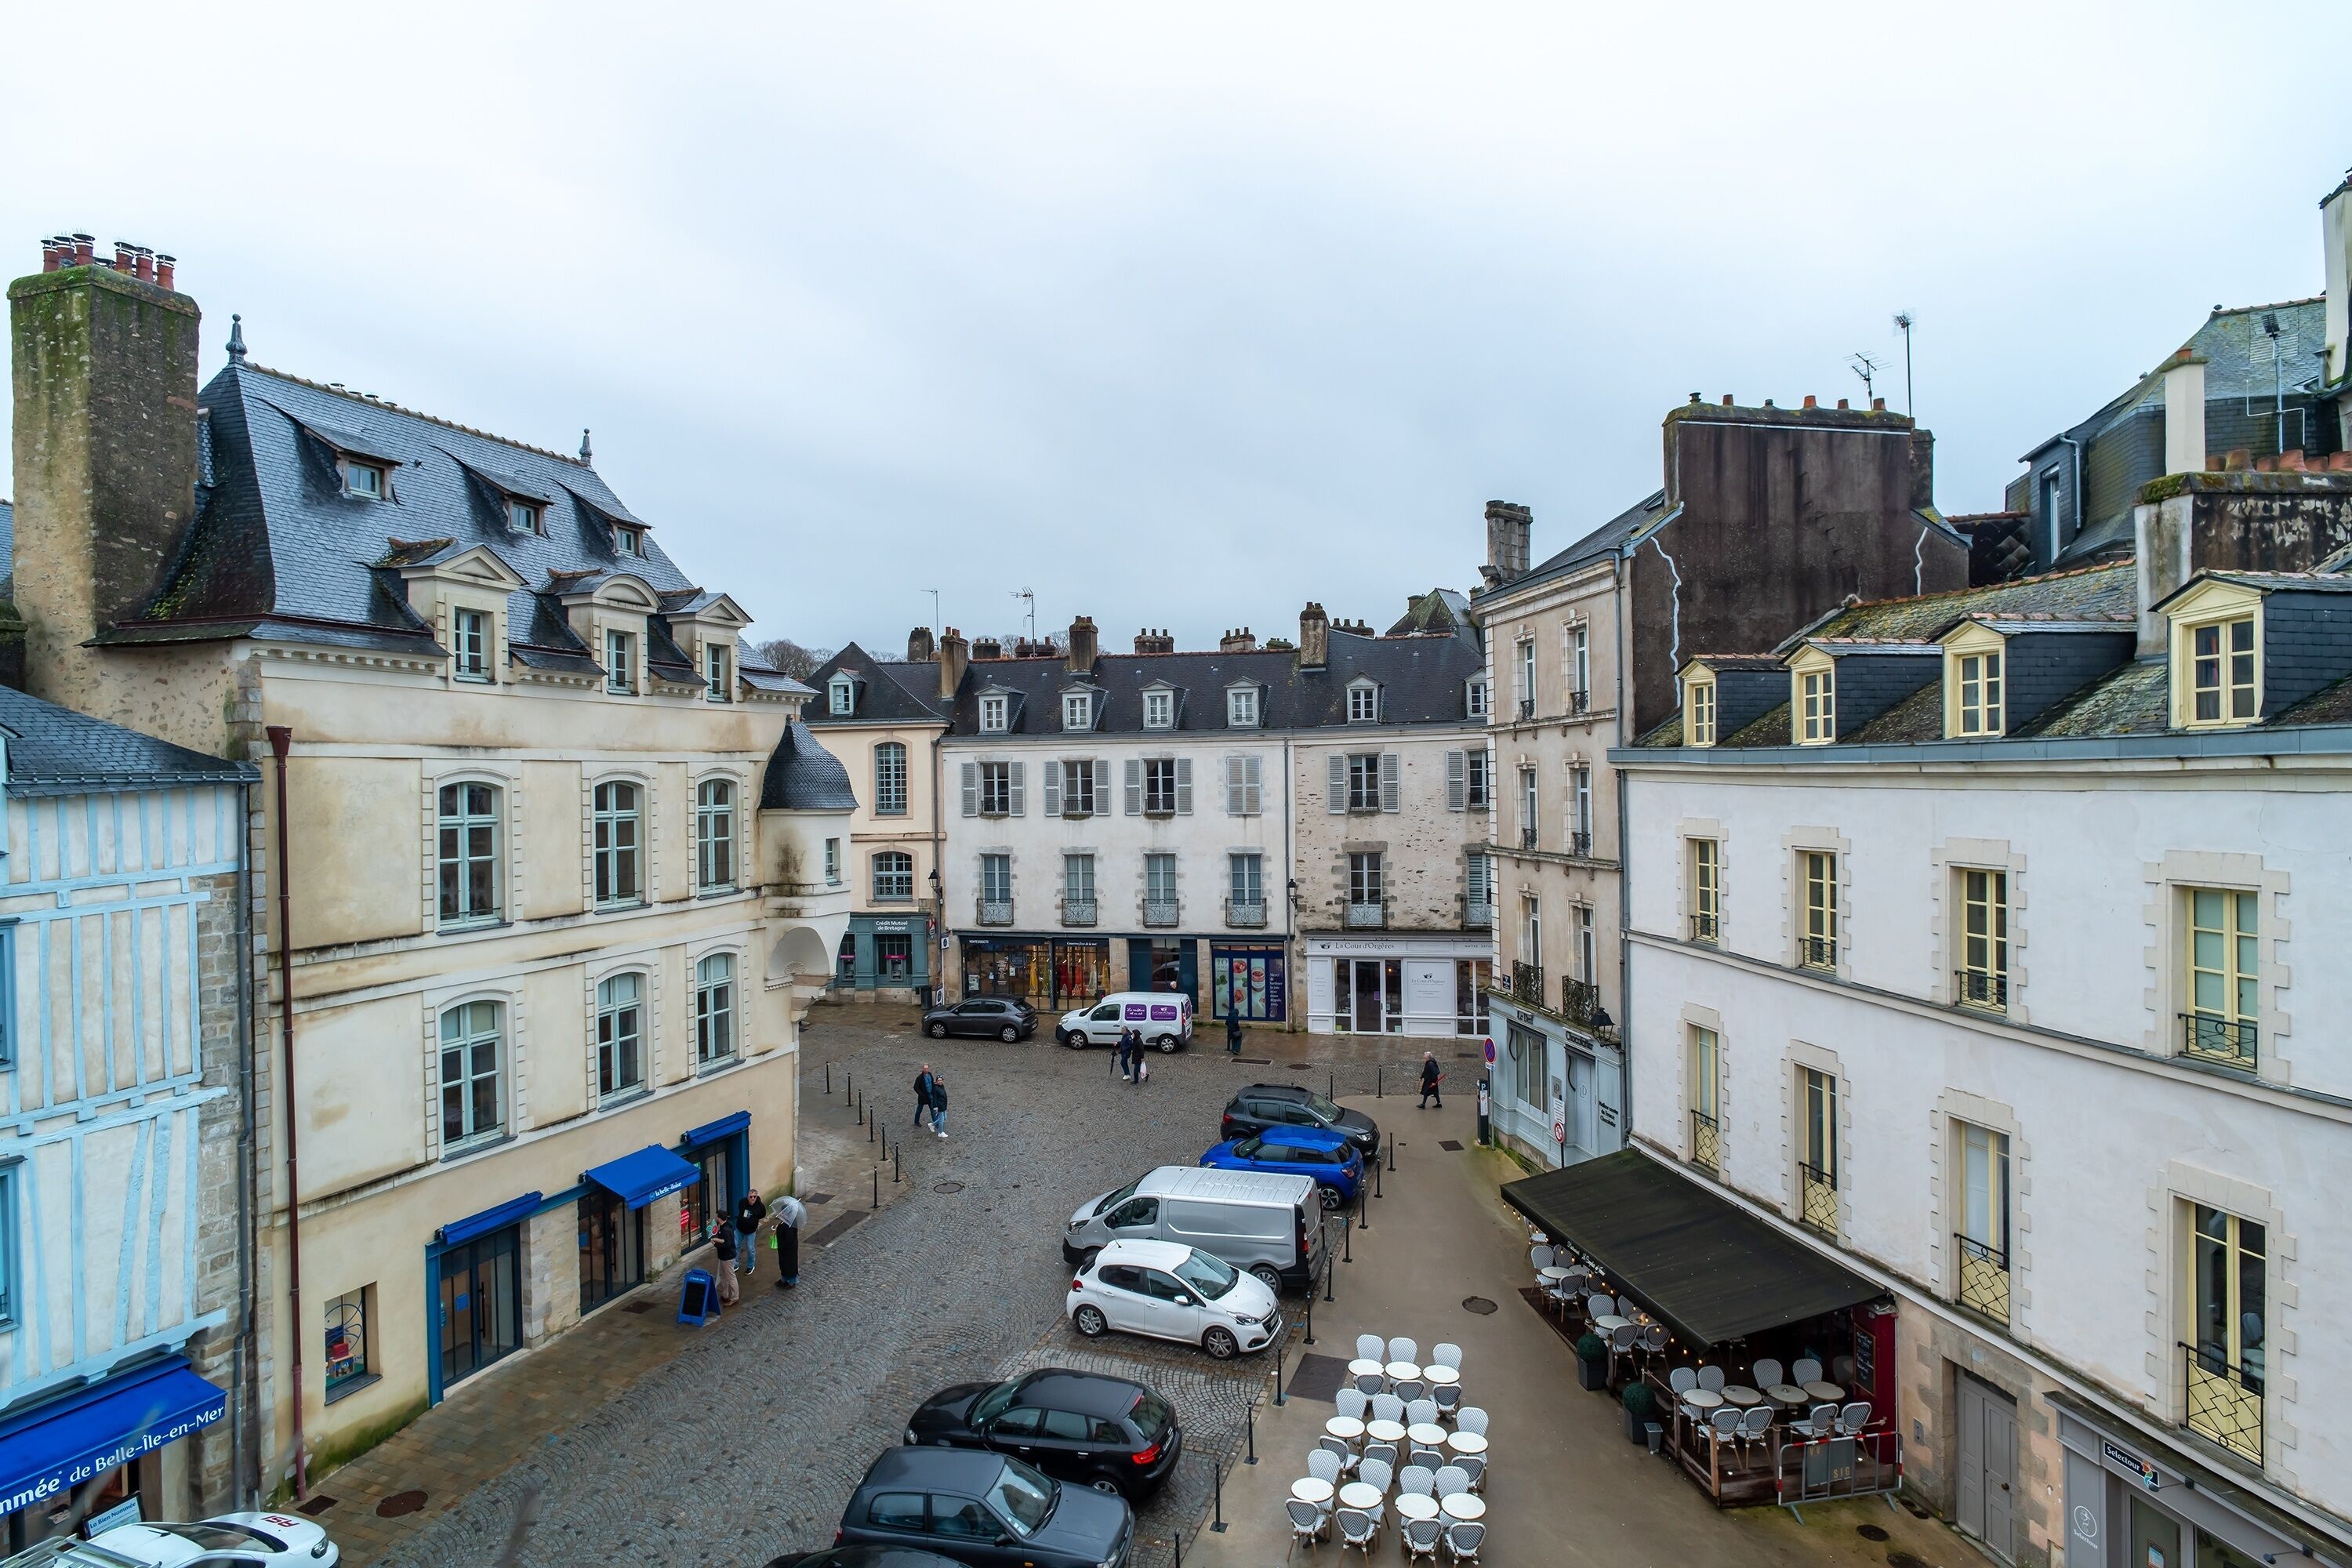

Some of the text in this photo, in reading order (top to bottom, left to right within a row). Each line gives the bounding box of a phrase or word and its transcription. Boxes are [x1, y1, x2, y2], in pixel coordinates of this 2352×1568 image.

[0, 1406, 224, 1515] mmée de Belle-Île-en-Mer
[2107, 1446, 2140, 1471] Selectour
[90, 1501, 136, 1530] La Bien Nommée
[2074, 1529, 2098, 1550] Selectour
